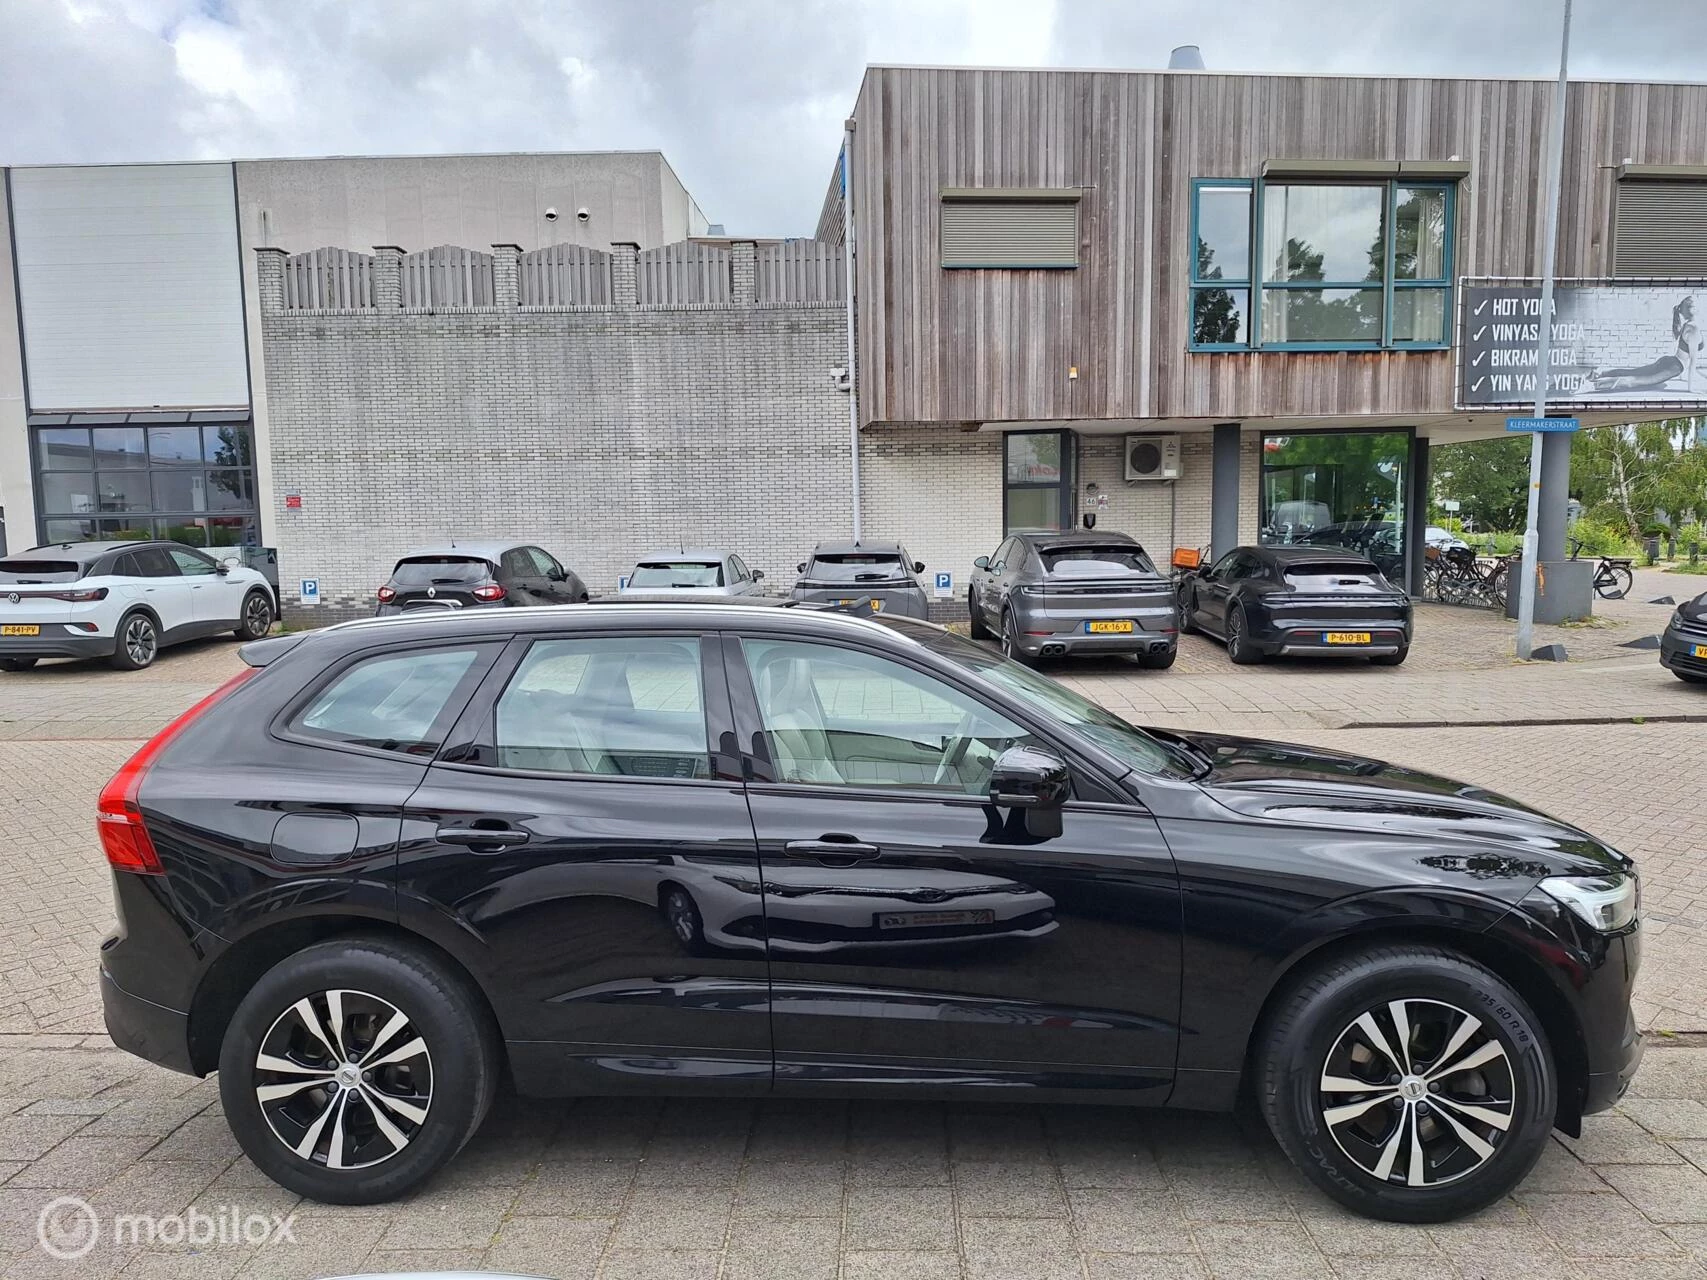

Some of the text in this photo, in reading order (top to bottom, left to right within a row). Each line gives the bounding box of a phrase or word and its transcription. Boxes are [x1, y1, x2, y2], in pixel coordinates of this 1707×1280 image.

[1493, 298, 1557, 316] HOT YOA
[1492, 323, 1586, 341] VINYAS YOGA
[1491, 349, 1539, 367] BIKRAM
[1490, 374, 1511, 392] YIN
[1553, 374, 1586, 391] YOGA
[1510, 421, 1577, 429] KLEERMAKERSTRAAT
[305, 582, 316, 594] P
[939, 575, 949, 587] P
[1094, 623, 1128, 631] JGK-16-X
